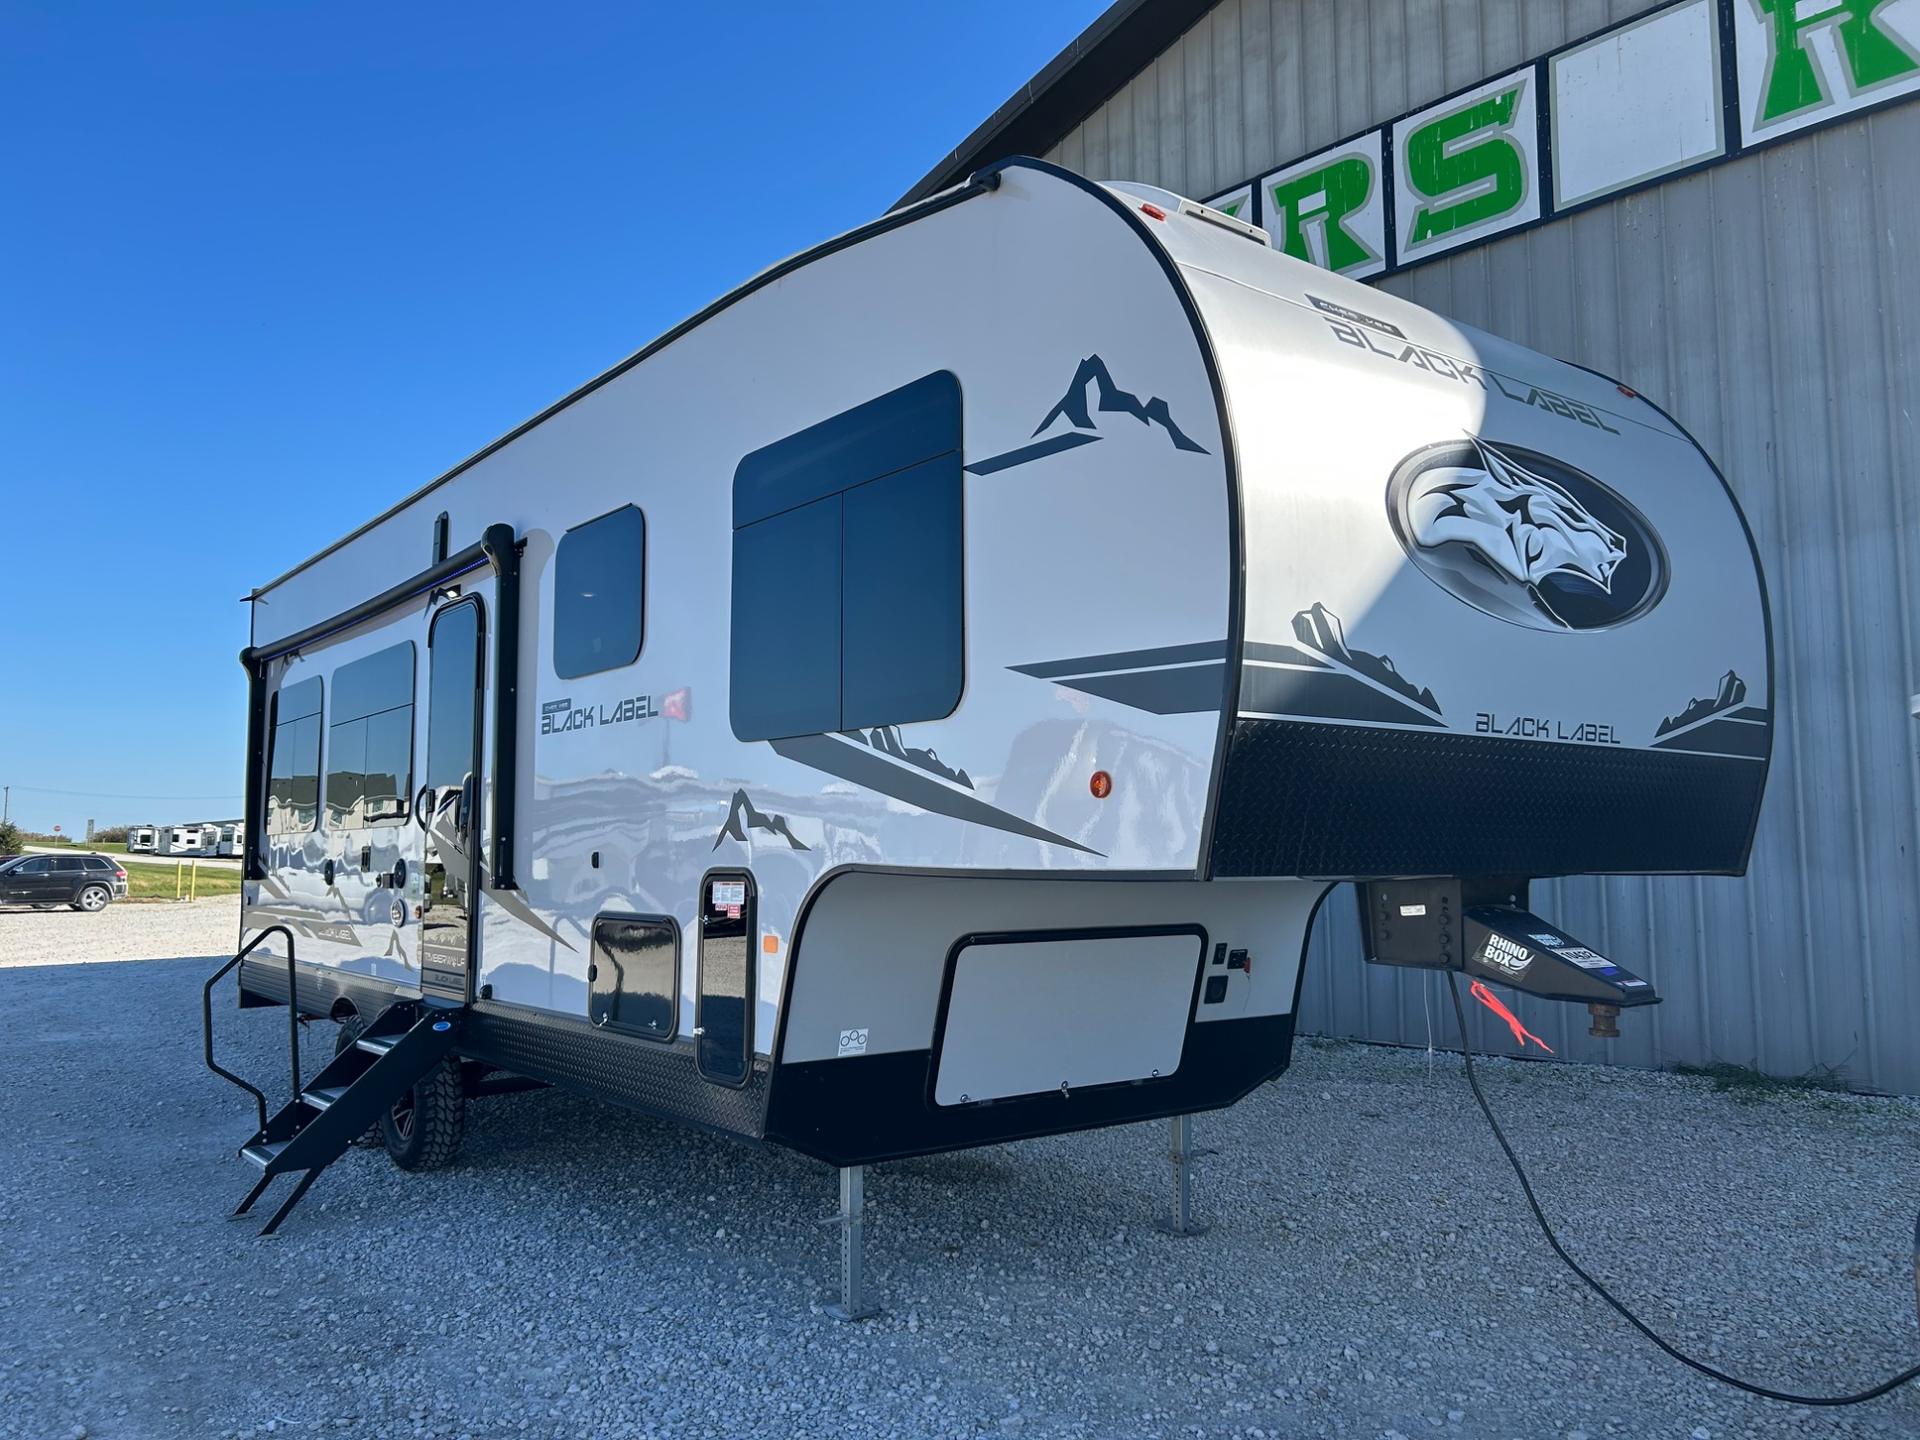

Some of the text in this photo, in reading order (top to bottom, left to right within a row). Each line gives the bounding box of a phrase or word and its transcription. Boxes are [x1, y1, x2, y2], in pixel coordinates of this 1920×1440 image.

[1210, 80, 1530, 274] RS
[1322, 316, 1488, 391] BLACK
[1487, 373, 1621, 436] LABEL
[542, 705, 595, 735] BLACK
[599, 695, 658, 726] LABEL
[1476, 713, 1621, 744] BLACK LABEL
[1484, 945, 1513, 968] BOX
[1488, 933, 1529, 960] RHINO
